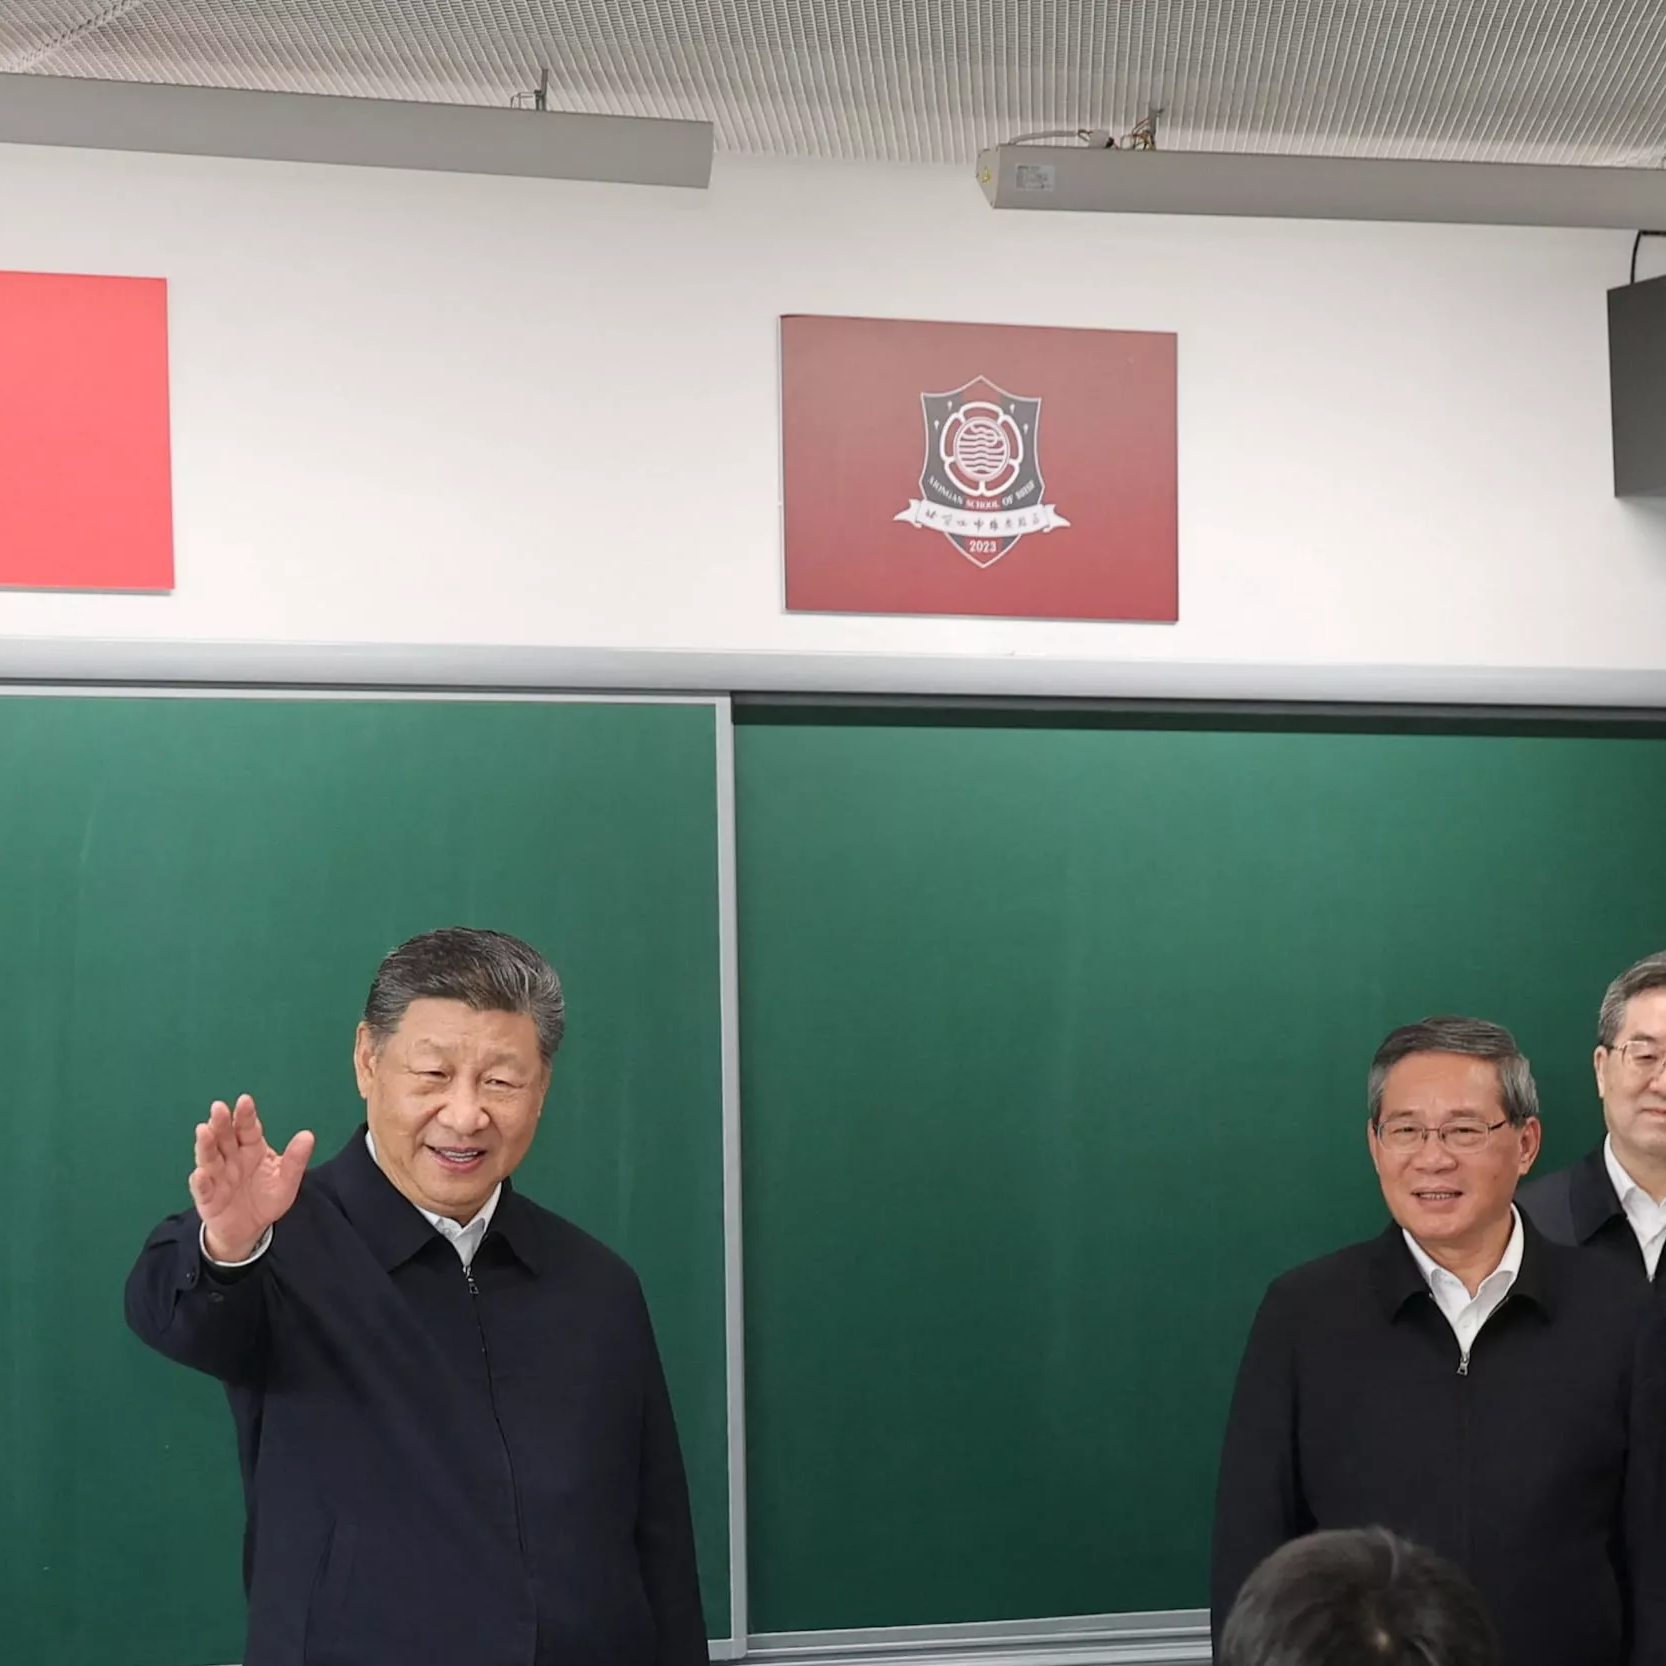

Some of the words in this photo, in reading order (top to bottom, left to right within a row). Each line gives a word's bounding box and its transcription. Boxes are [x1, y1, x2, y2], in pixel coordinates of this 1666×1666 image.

[965, 498, 1000, 510] SCHOOL
[1001, 495, 1015, 507] OF
[969, 540, 997, 553] 2023
